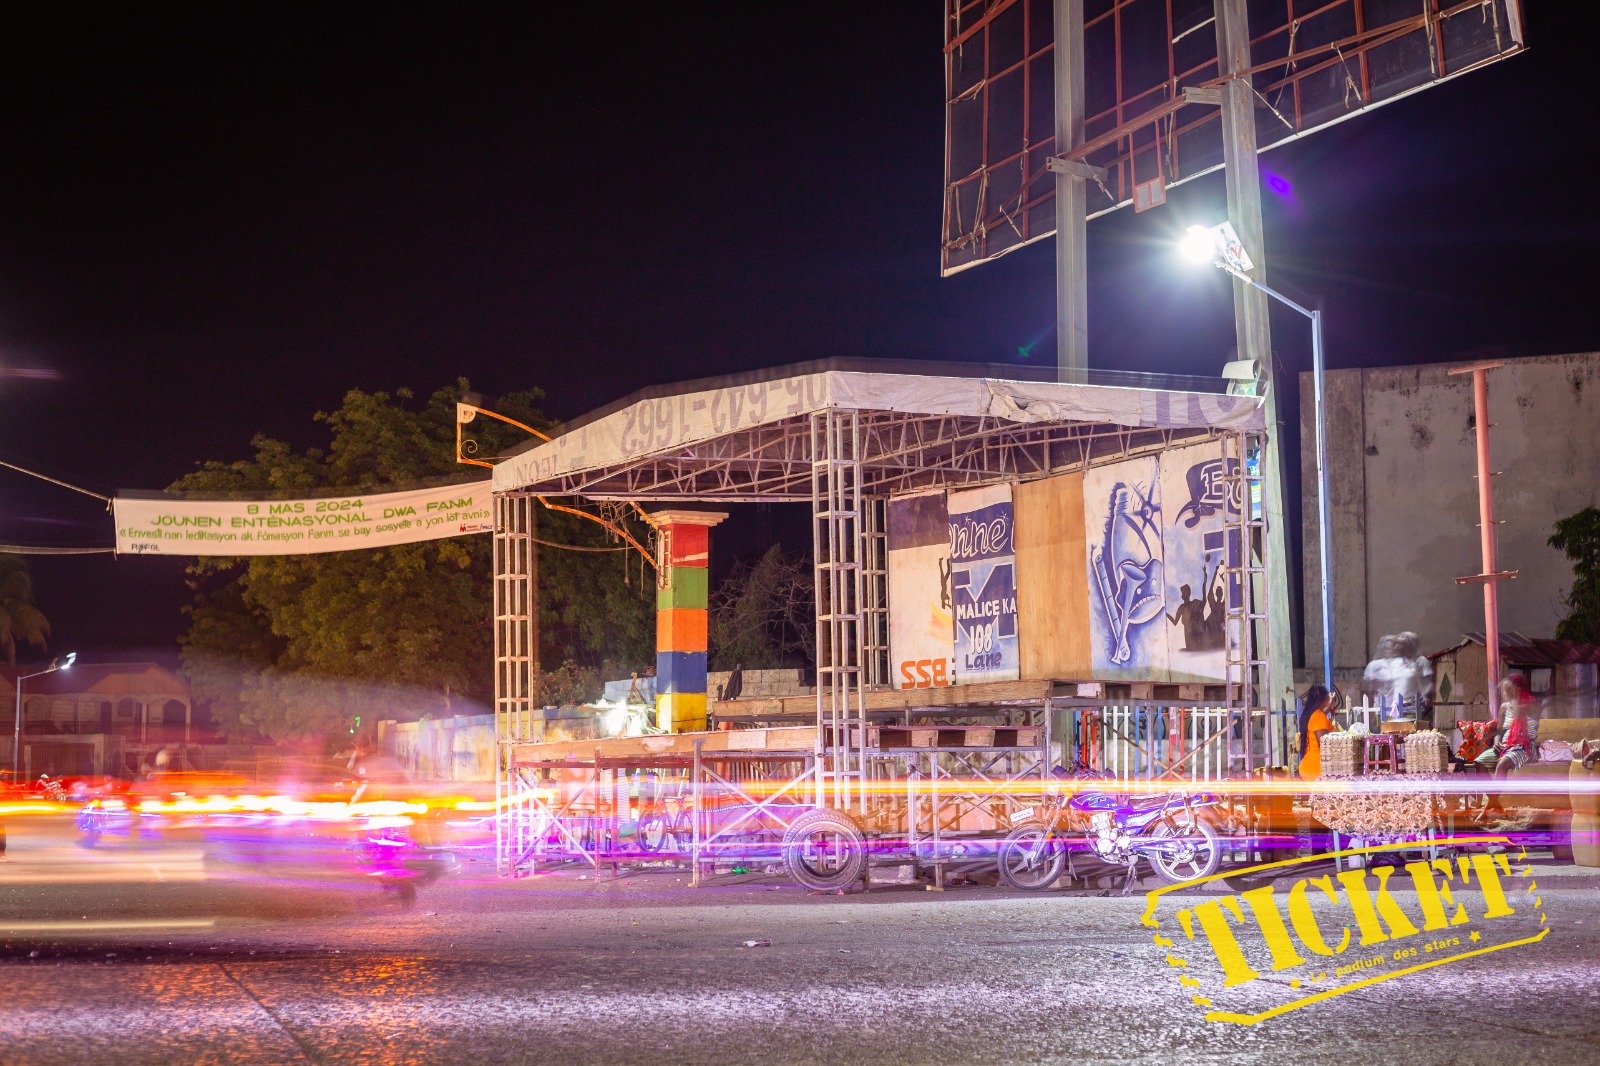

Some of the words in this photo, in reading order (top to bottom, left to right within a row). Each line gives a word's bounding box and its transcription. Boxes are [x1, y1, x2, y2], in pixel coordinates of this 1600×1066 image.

[150, 515, 222, 527] JOUNEN
[231, 512, 373, 528] ENTÈNASYONAL
[383, 506, 417, 519] DWA
[426, 496, 473, 513] FANM
[247, 503, 259, 515] 8
[269, 503, 305, 515] MAS
[315, 499, 363, 513] 2024
[164, 531, 183, 540] nan
[338, 528, 350, 538] se
[353, 525, 371, 538] bay
[425, 514, 444, 528] yon
[957, 600, 1000, 620] MALICE
[965, 651, 1003, 670] Lane
